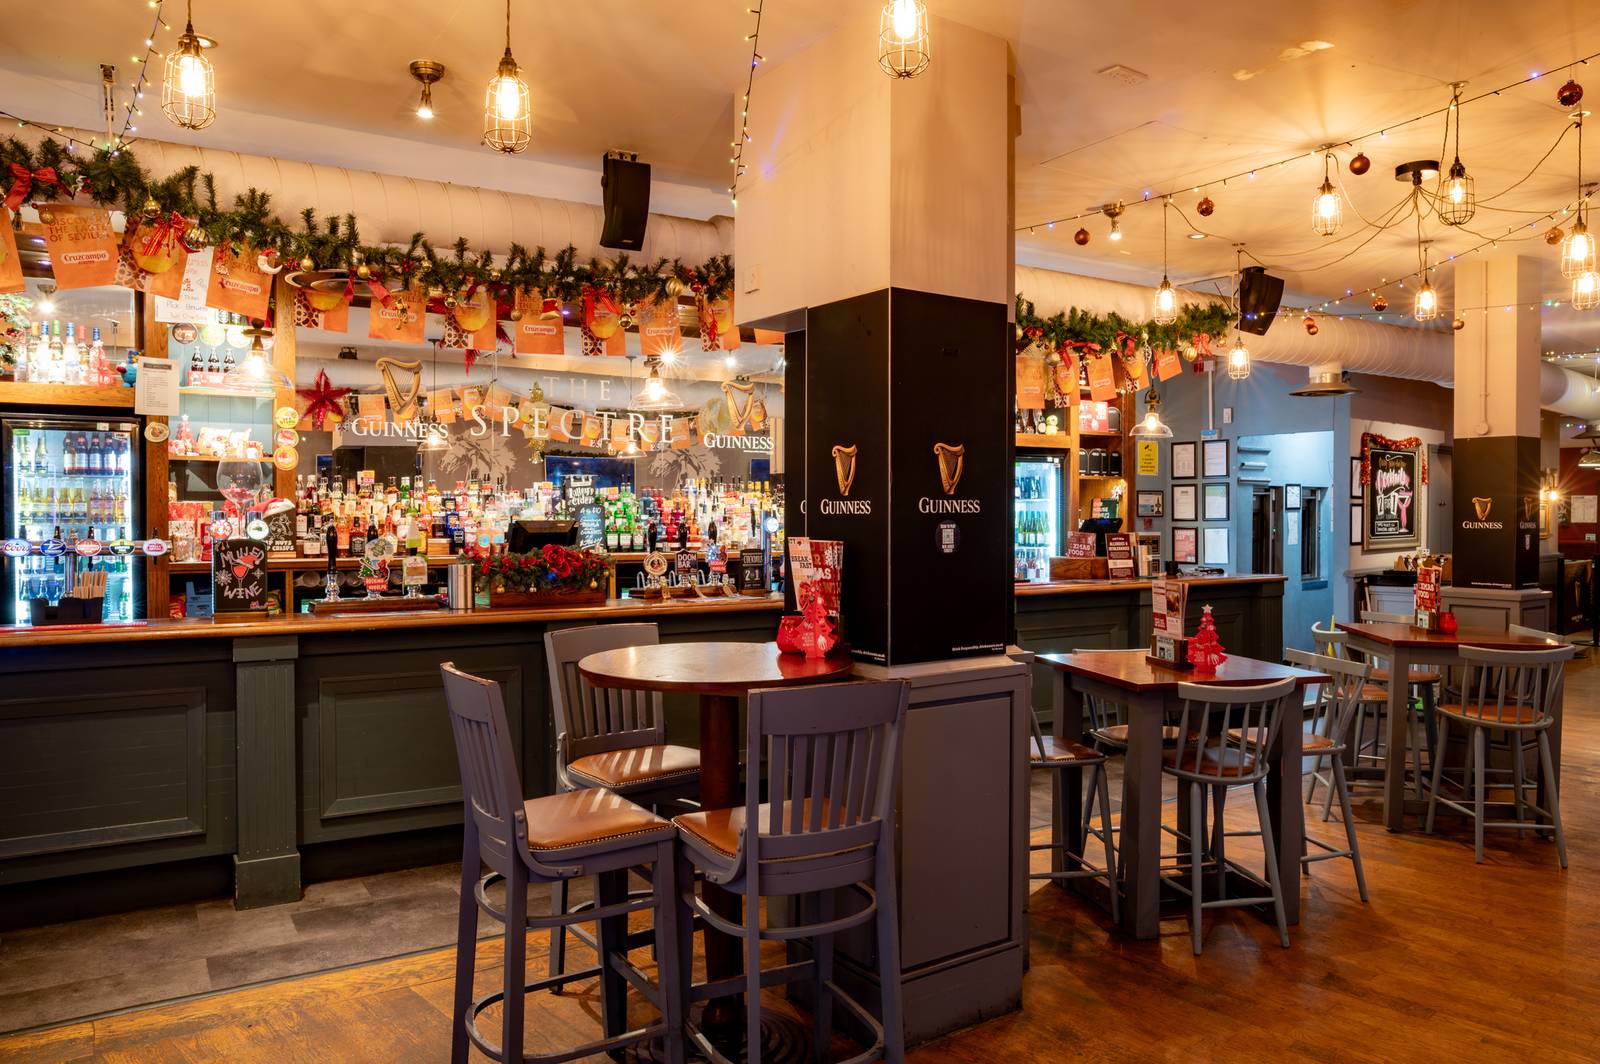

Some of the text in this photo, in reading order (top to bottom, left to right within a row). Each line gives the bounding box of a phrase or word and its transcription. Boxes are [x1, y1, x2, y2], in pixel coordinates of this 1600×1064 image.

[50, 234, 64, 242] OF
[64, 252, 106, 262] Cruzcampo
[543, 376, 611, 401] THE
[351, 417, 449, 439] GUINNESS
[470, 404, 675, 443] SPECTRE
[703, 432, 775, 450] GUINNESS
[820, 498, 872, 515] GUINNESS
[918, 496, 981, 514] GUINNESS
[1462, 520, 1503, 530] GUINNESS
[677, 560, 692, 569] BAR
[224, 581, 263, 599] WINE
